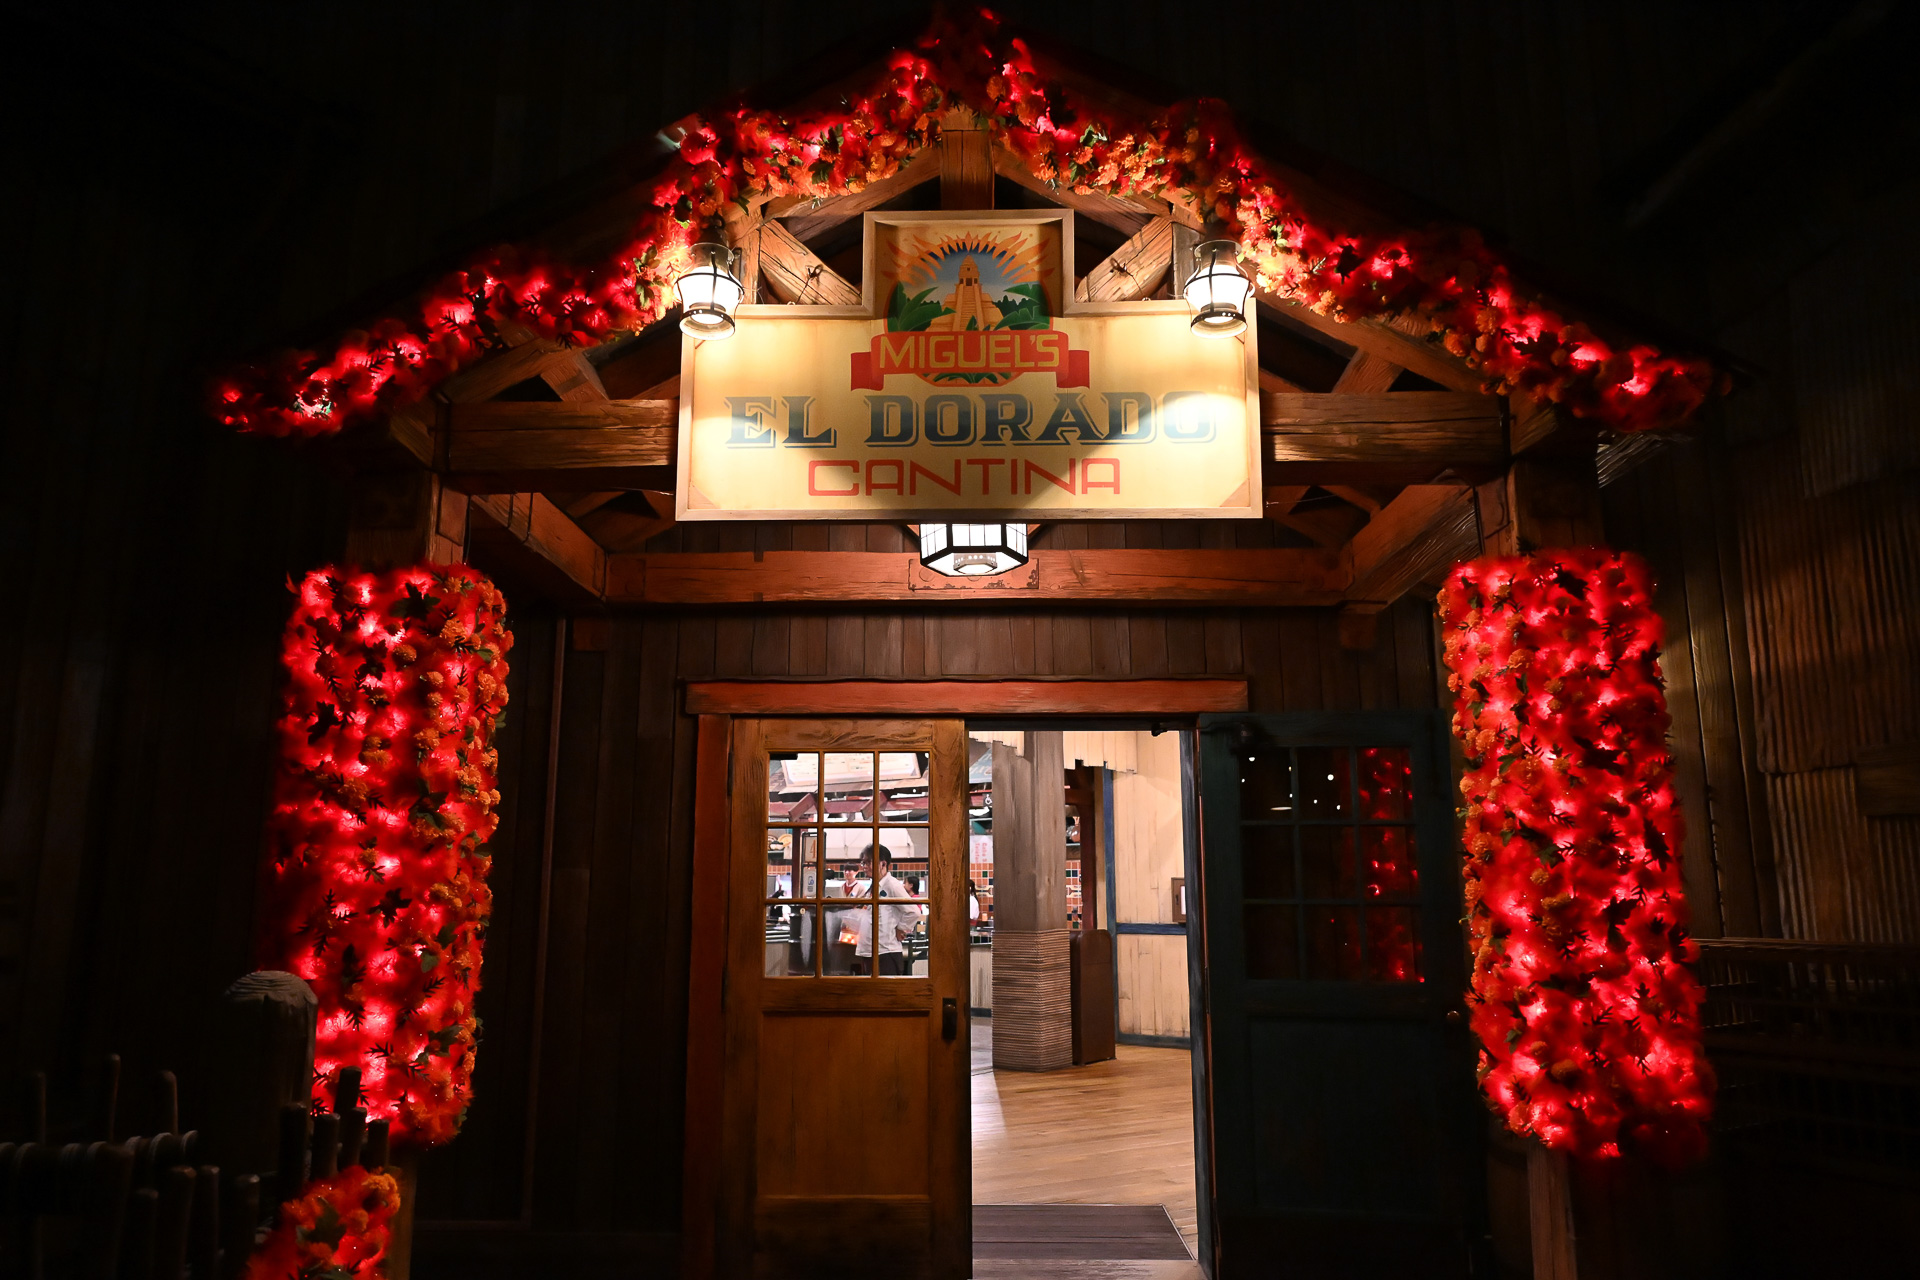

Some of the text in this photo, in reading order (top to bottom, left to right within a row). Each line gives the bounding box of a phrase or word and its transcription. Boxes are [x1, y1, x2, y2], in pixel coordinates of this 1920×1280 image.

[880, 334, 1060, 369] MIGUEL'S
[724, 391, 1217, 448] EL DORADO
[808, 457, 1121, 496] CANTINA
